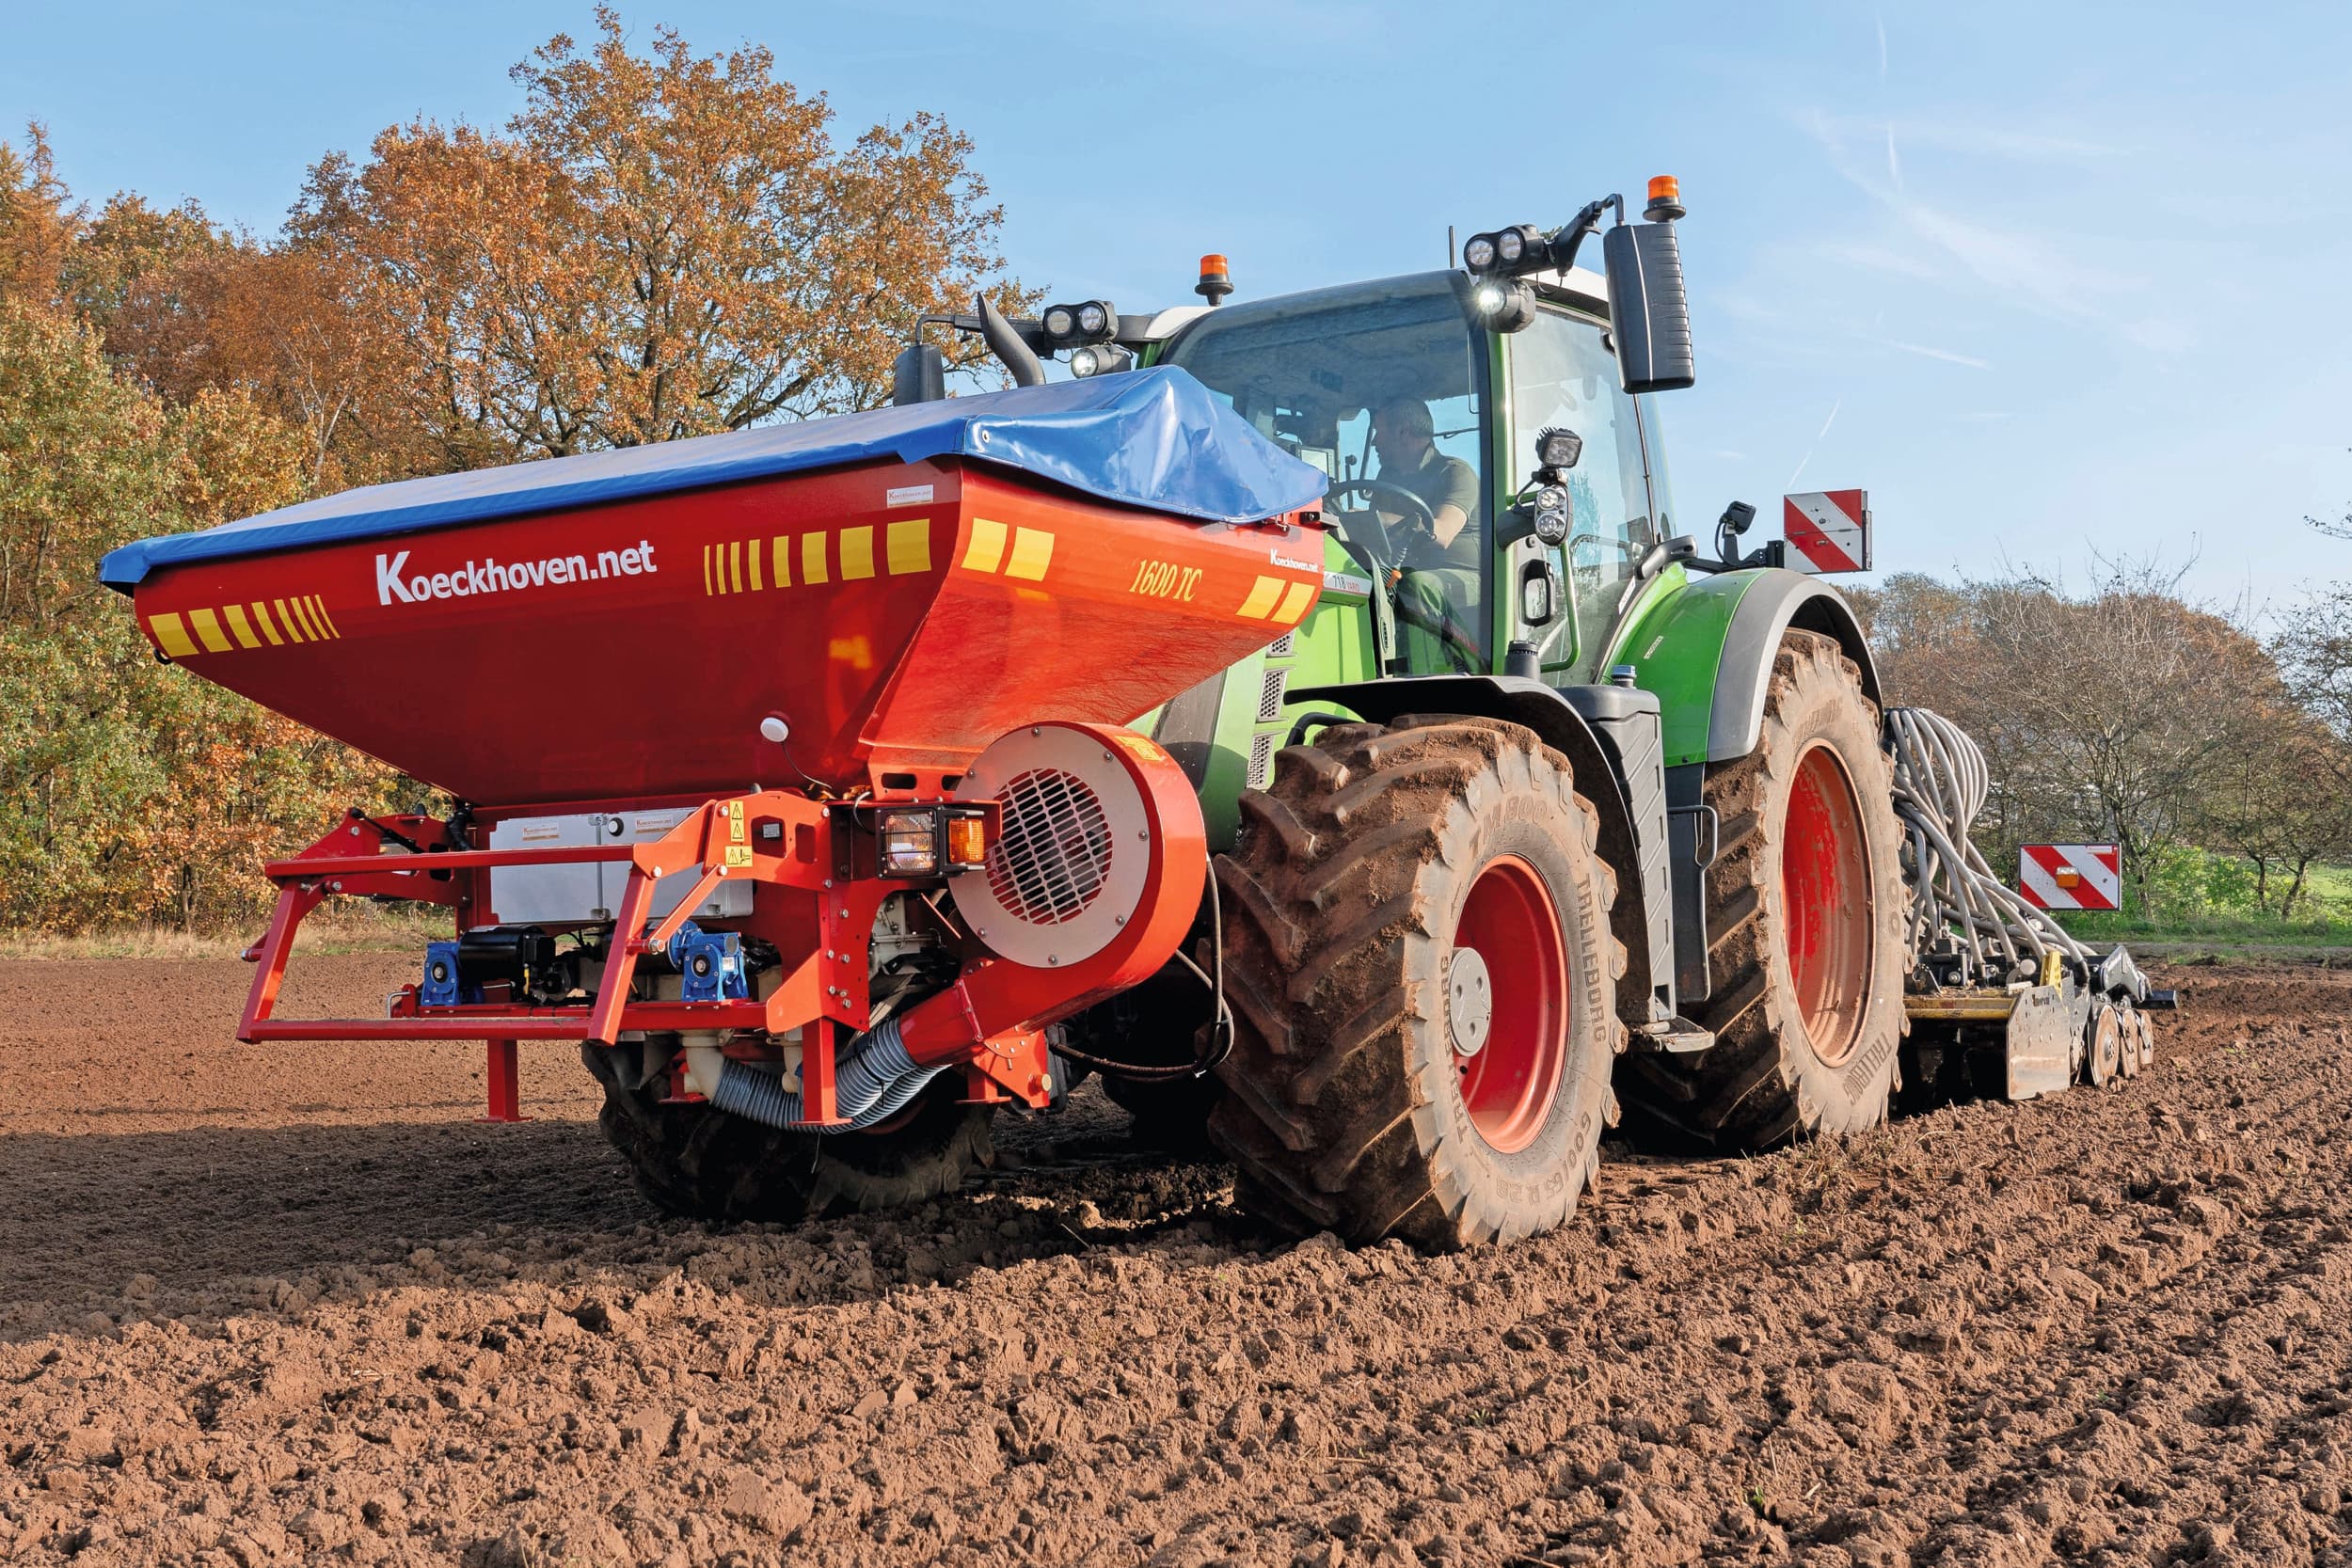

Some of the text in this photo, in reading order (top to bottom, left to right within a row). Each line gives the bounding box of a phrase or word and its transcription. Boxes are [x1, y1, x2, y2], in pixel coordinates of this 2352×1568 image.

[376, 540, 657, 606] Koeckhoven.net
[1129, 559, 1203, 602] 1600 TC
[1270, 548, 1319, 572] Koeckhoven.net
[1577, 873, 1607, 1042] TRELLEBORG
